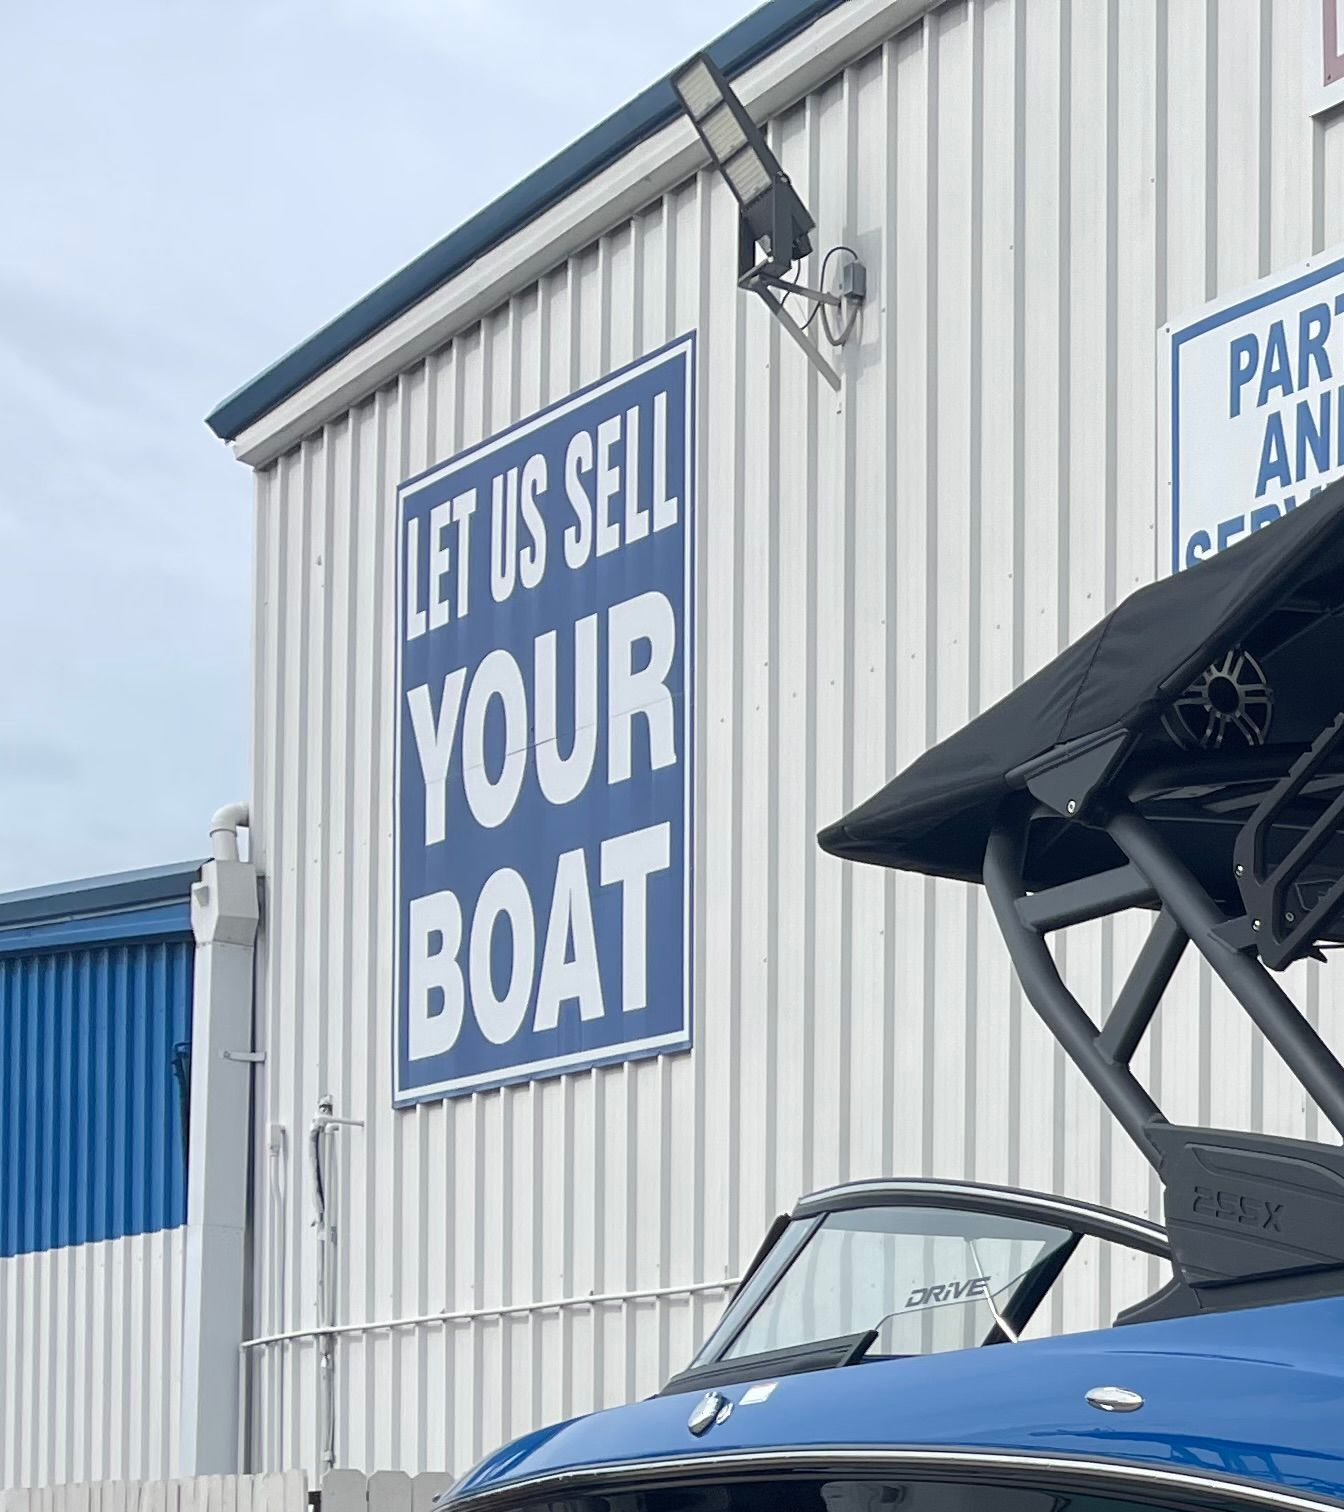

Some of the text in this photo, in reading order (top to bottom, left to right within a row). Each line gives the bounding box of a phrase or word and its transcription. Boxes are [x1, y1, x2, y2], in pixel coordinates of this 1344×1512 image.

[405, 391, 679, 641] LET US SELL
[406, 590, 678, 847] YOUR
[408, 821, 671, 1062] BOAT
[1192, 1185, 1284, 1233] 255X
